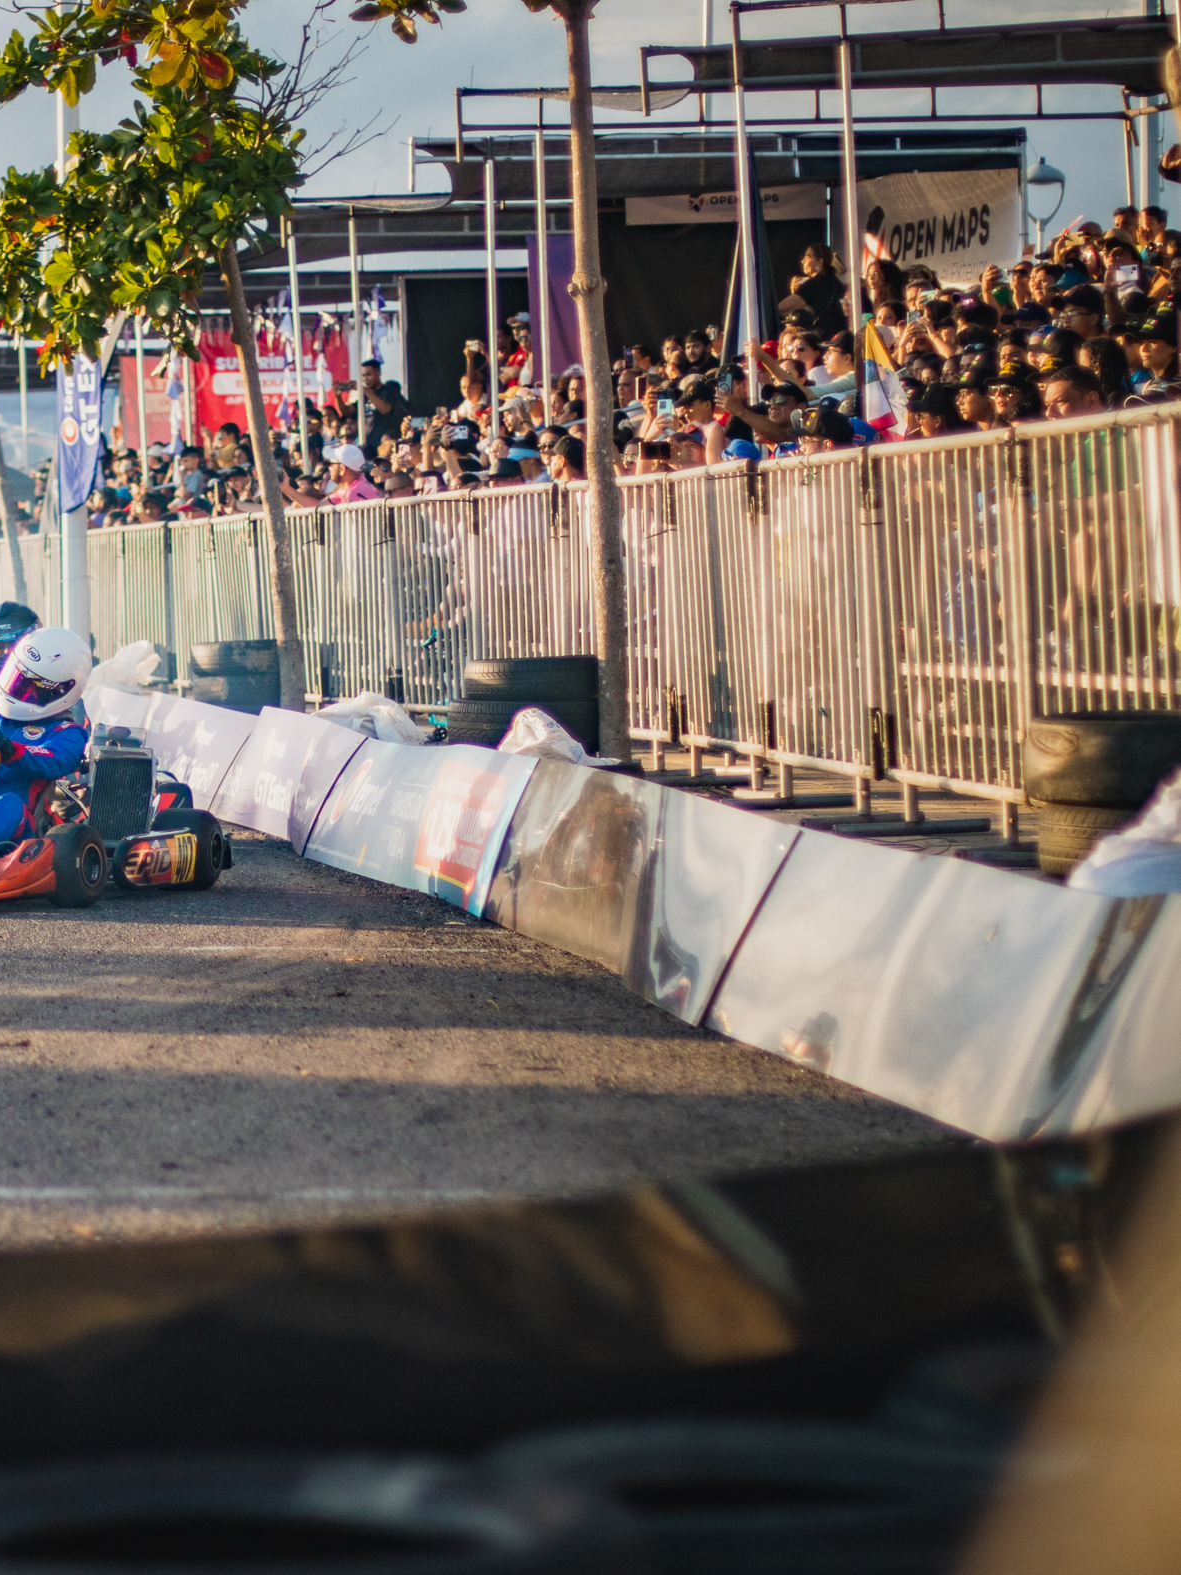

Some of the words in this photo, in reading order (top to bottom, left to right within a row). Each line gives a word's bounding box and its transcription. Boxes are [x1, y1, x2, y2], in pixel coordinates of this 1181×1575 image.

[889, 216, 937, 262] OPEN
[941, 204, 991, 254] MAPS
[79, 398, 99, 446] GT
[26, 647, 40, 661] Arai
[350, 775, 392, 826] terpel
